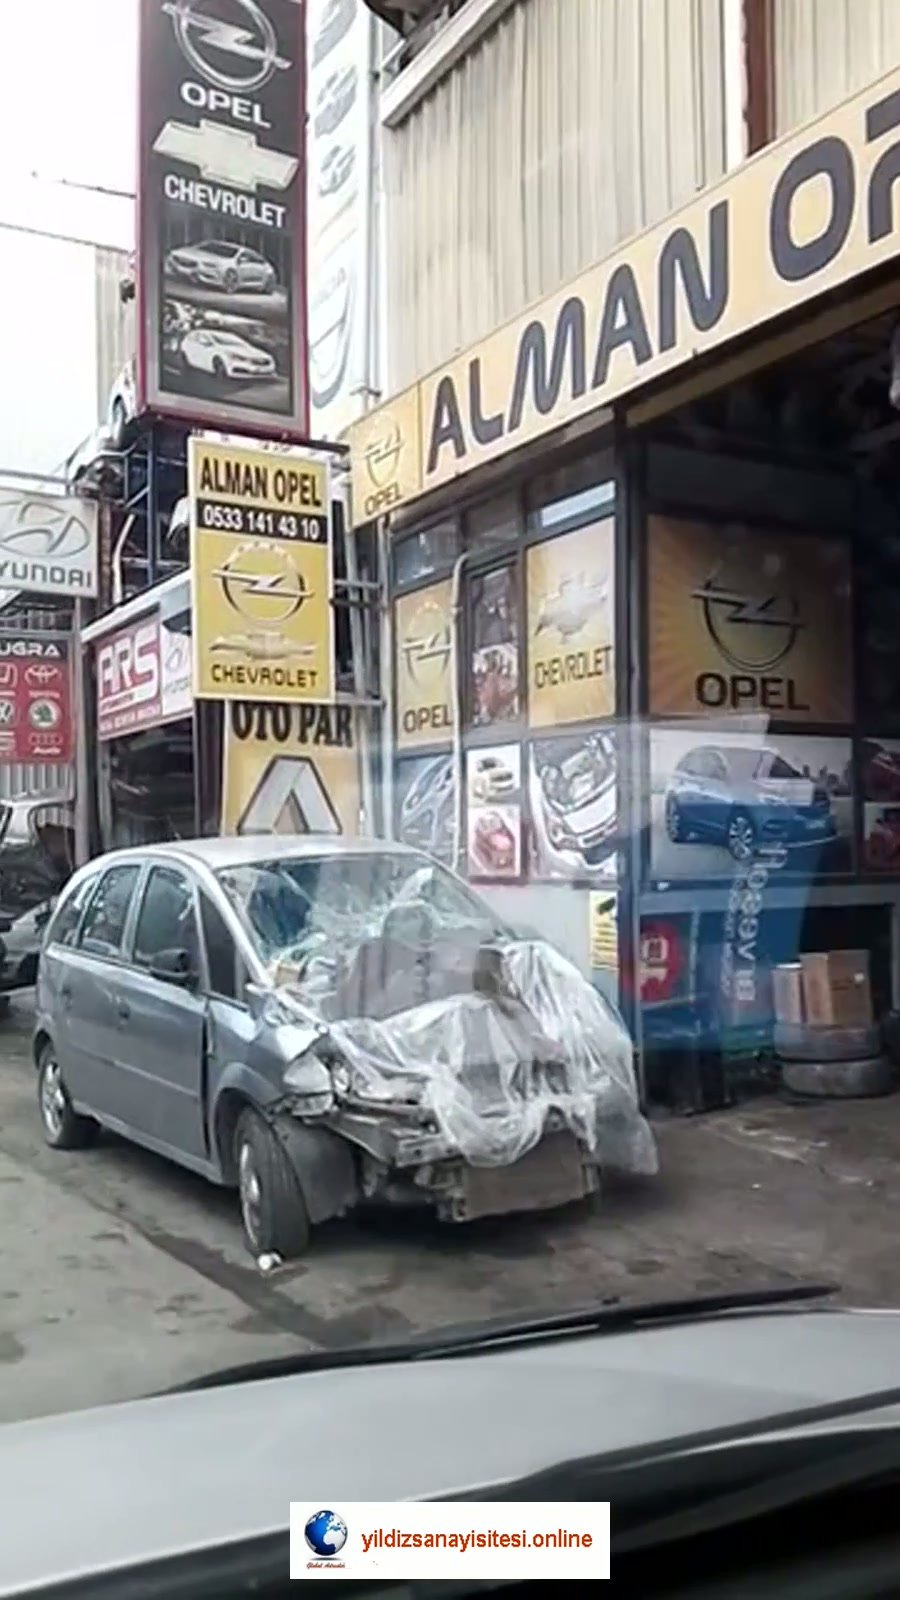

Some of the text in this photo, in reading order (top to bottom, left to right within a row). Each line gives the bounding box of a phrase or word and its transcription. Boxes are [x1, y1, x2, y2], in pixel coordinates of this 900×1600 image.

[180, 81, 272, 129] OPEL
[163, 173, 287, 229] CHEVROLET
[427, 198, 730, 474] ALMAN
[200, 456, 323, 508] ALMAN OPEL
[364, 480, 402, 517] OPEL
[204, 503, 320, 541] 0533 141 43 10
[97, 621, 160, 700] ARS
[210, 662, 319, 689] CHEVROLET
[535, 645, 613, 690] CHEVROLET
[696, 671, 811, 712] OPEL
[231, 700, 354, 749] OTO PAR
[403, 703, 454, 735] OPEL
